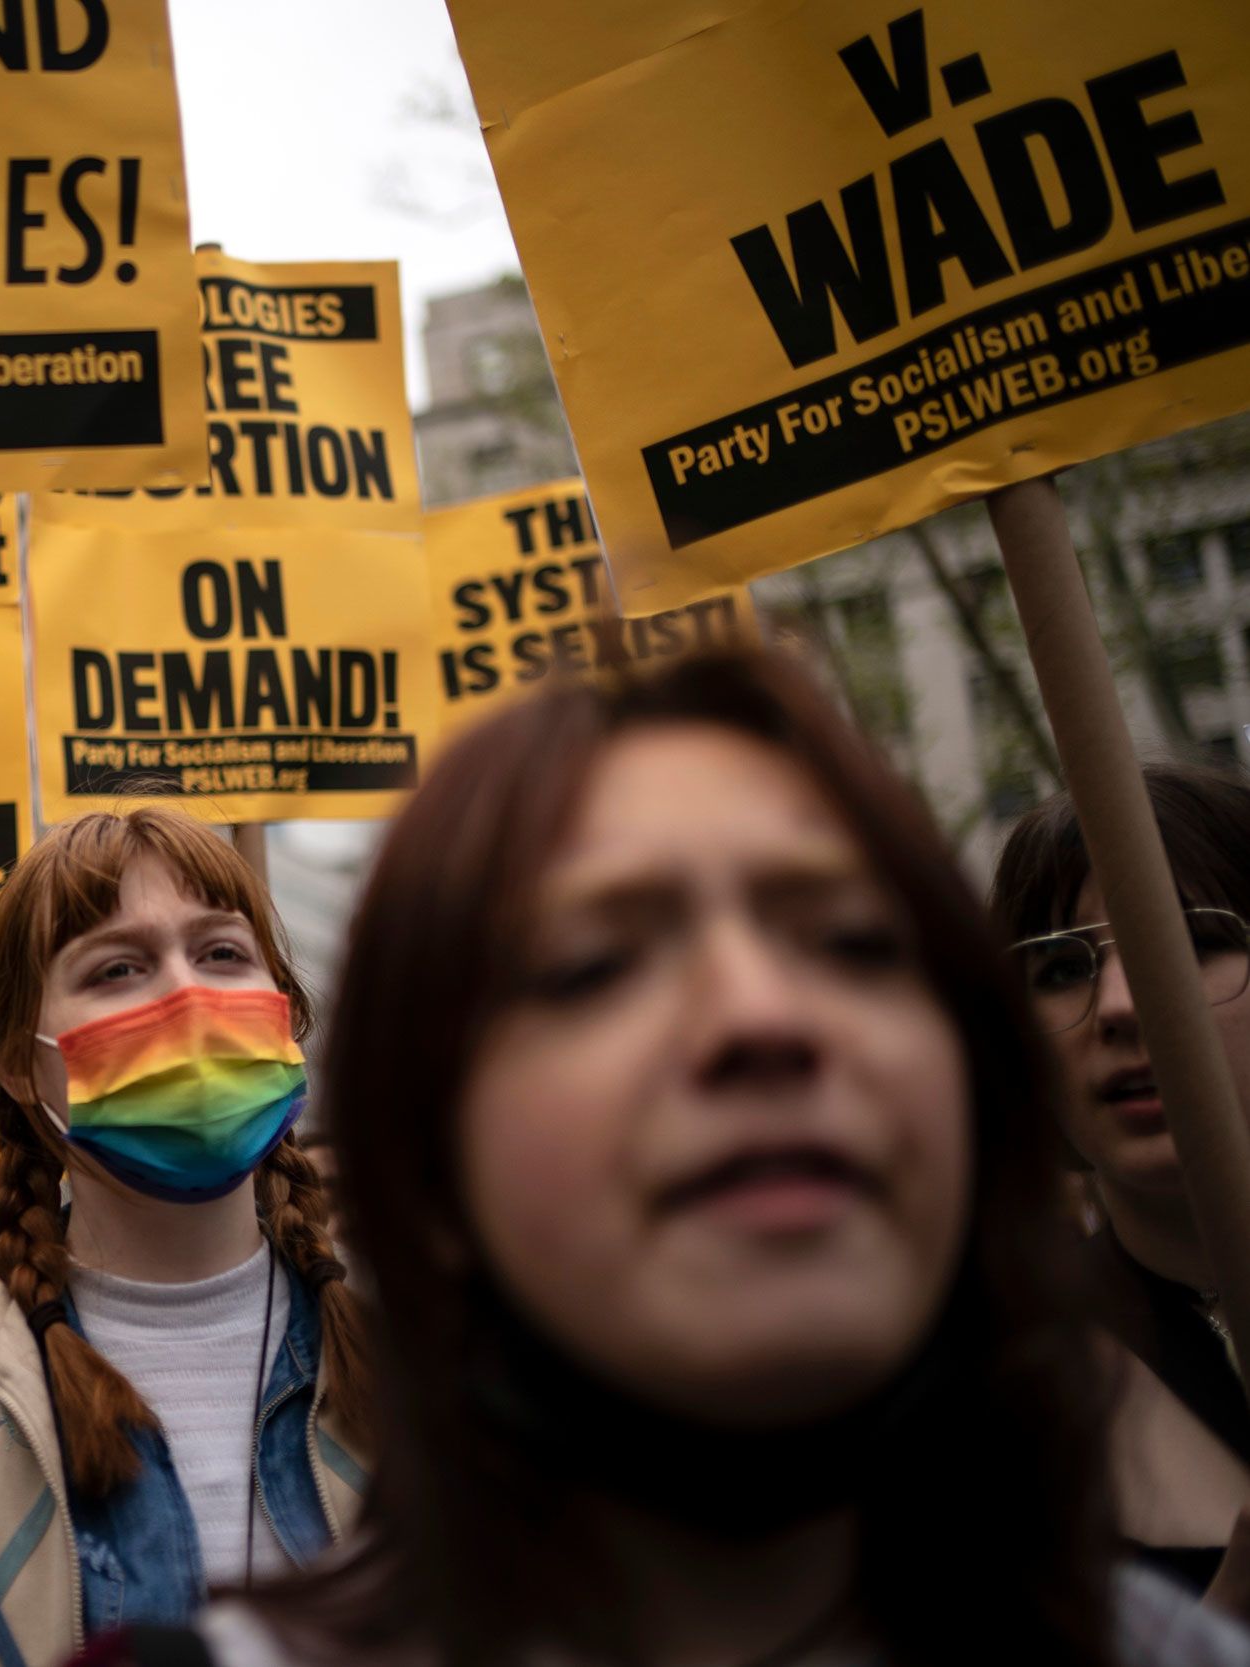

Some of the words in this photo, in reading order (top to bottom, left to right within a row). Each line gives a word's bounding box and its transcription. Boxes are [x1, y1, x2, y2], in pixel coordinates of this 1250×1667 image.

[729, 49, 1227, 370] WADE
[200, 285, 345, 337] LOGIES
[668, 422, 771, 485] Party
[777, 394, 844, 444] For
[850, 311, 1048, 415] Socialism
[1057, 271, 1142, 334] and
[1149, 243, 1250, 303] Libe
[893, 328, 1158, 453] PSLWEB.org
[505, 497, 598, 556] TH
[180, 559, 288, 641] ON
[70, 648, 400, 734] DEMAND!
[440, 643, 500, 700] IS
[71, 739, 124, 769] Party
[164, 739, 272, 766] Socialism
[311, 739, 408, 763] Liberation
